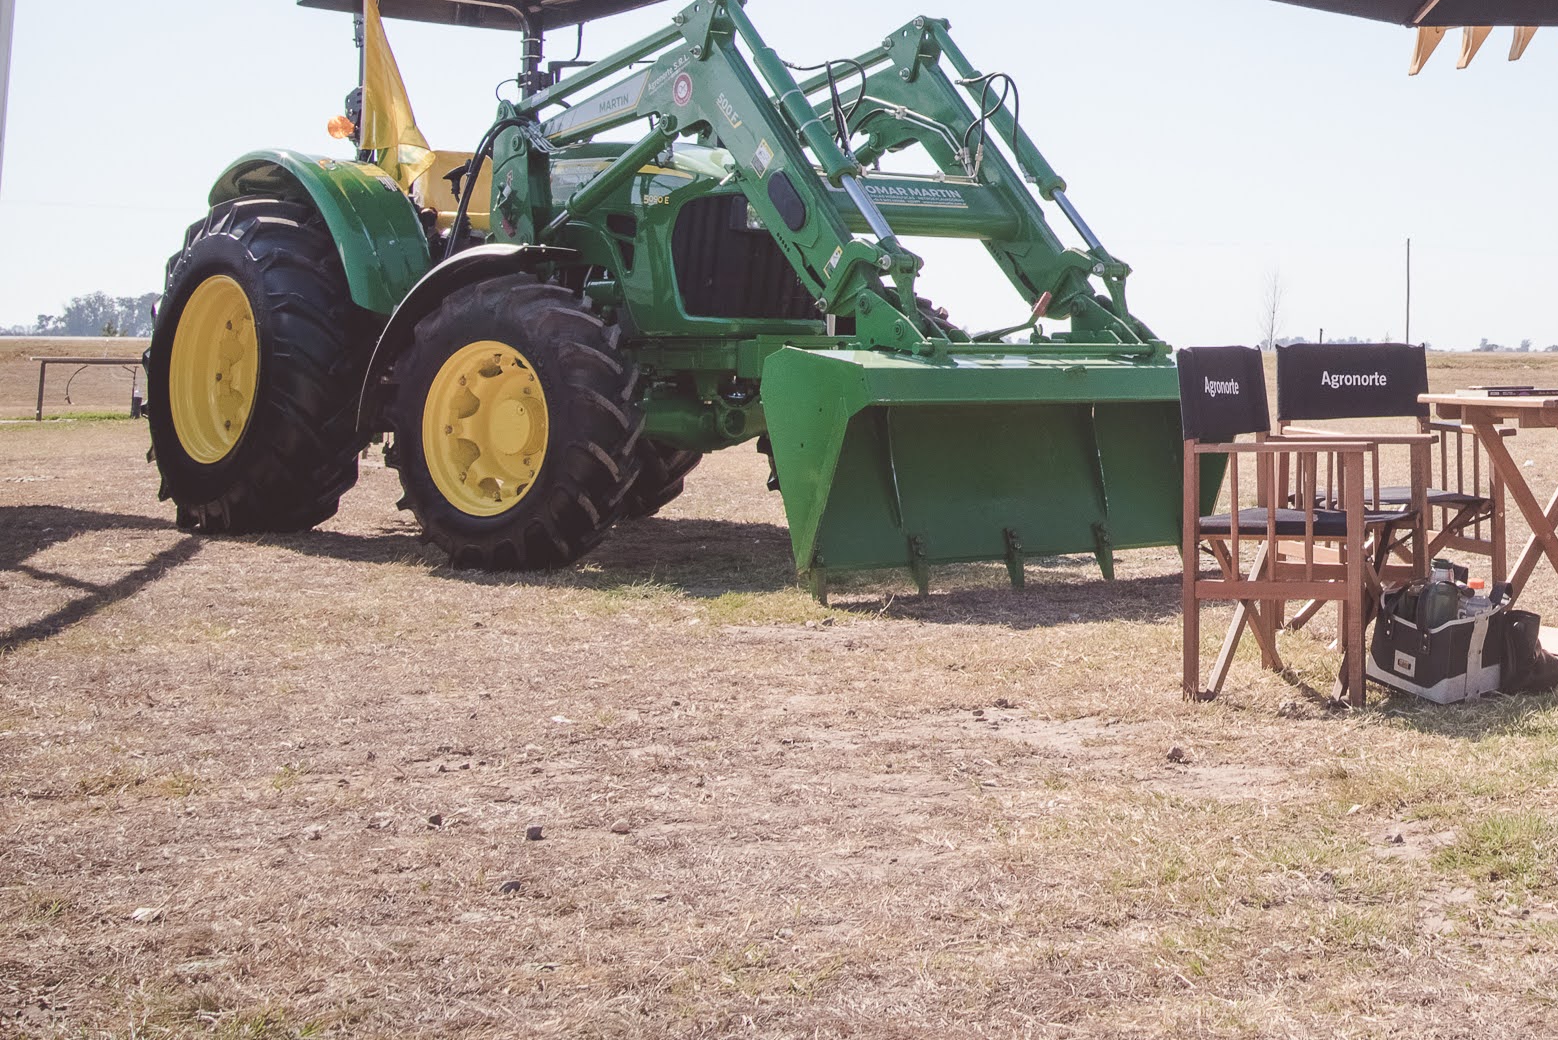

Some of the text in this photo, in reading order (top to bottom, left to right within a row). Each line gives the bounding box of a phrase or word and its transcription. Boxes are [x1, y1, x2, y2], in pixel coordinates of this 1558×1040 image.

[599, 94, 629, 112] MARTIN
[865, 186, 961, 198] OMAR MARTIN
[1204, 376, 1239, 398] Agronorte
[1321, 370, 1387, 389] Agronorte
